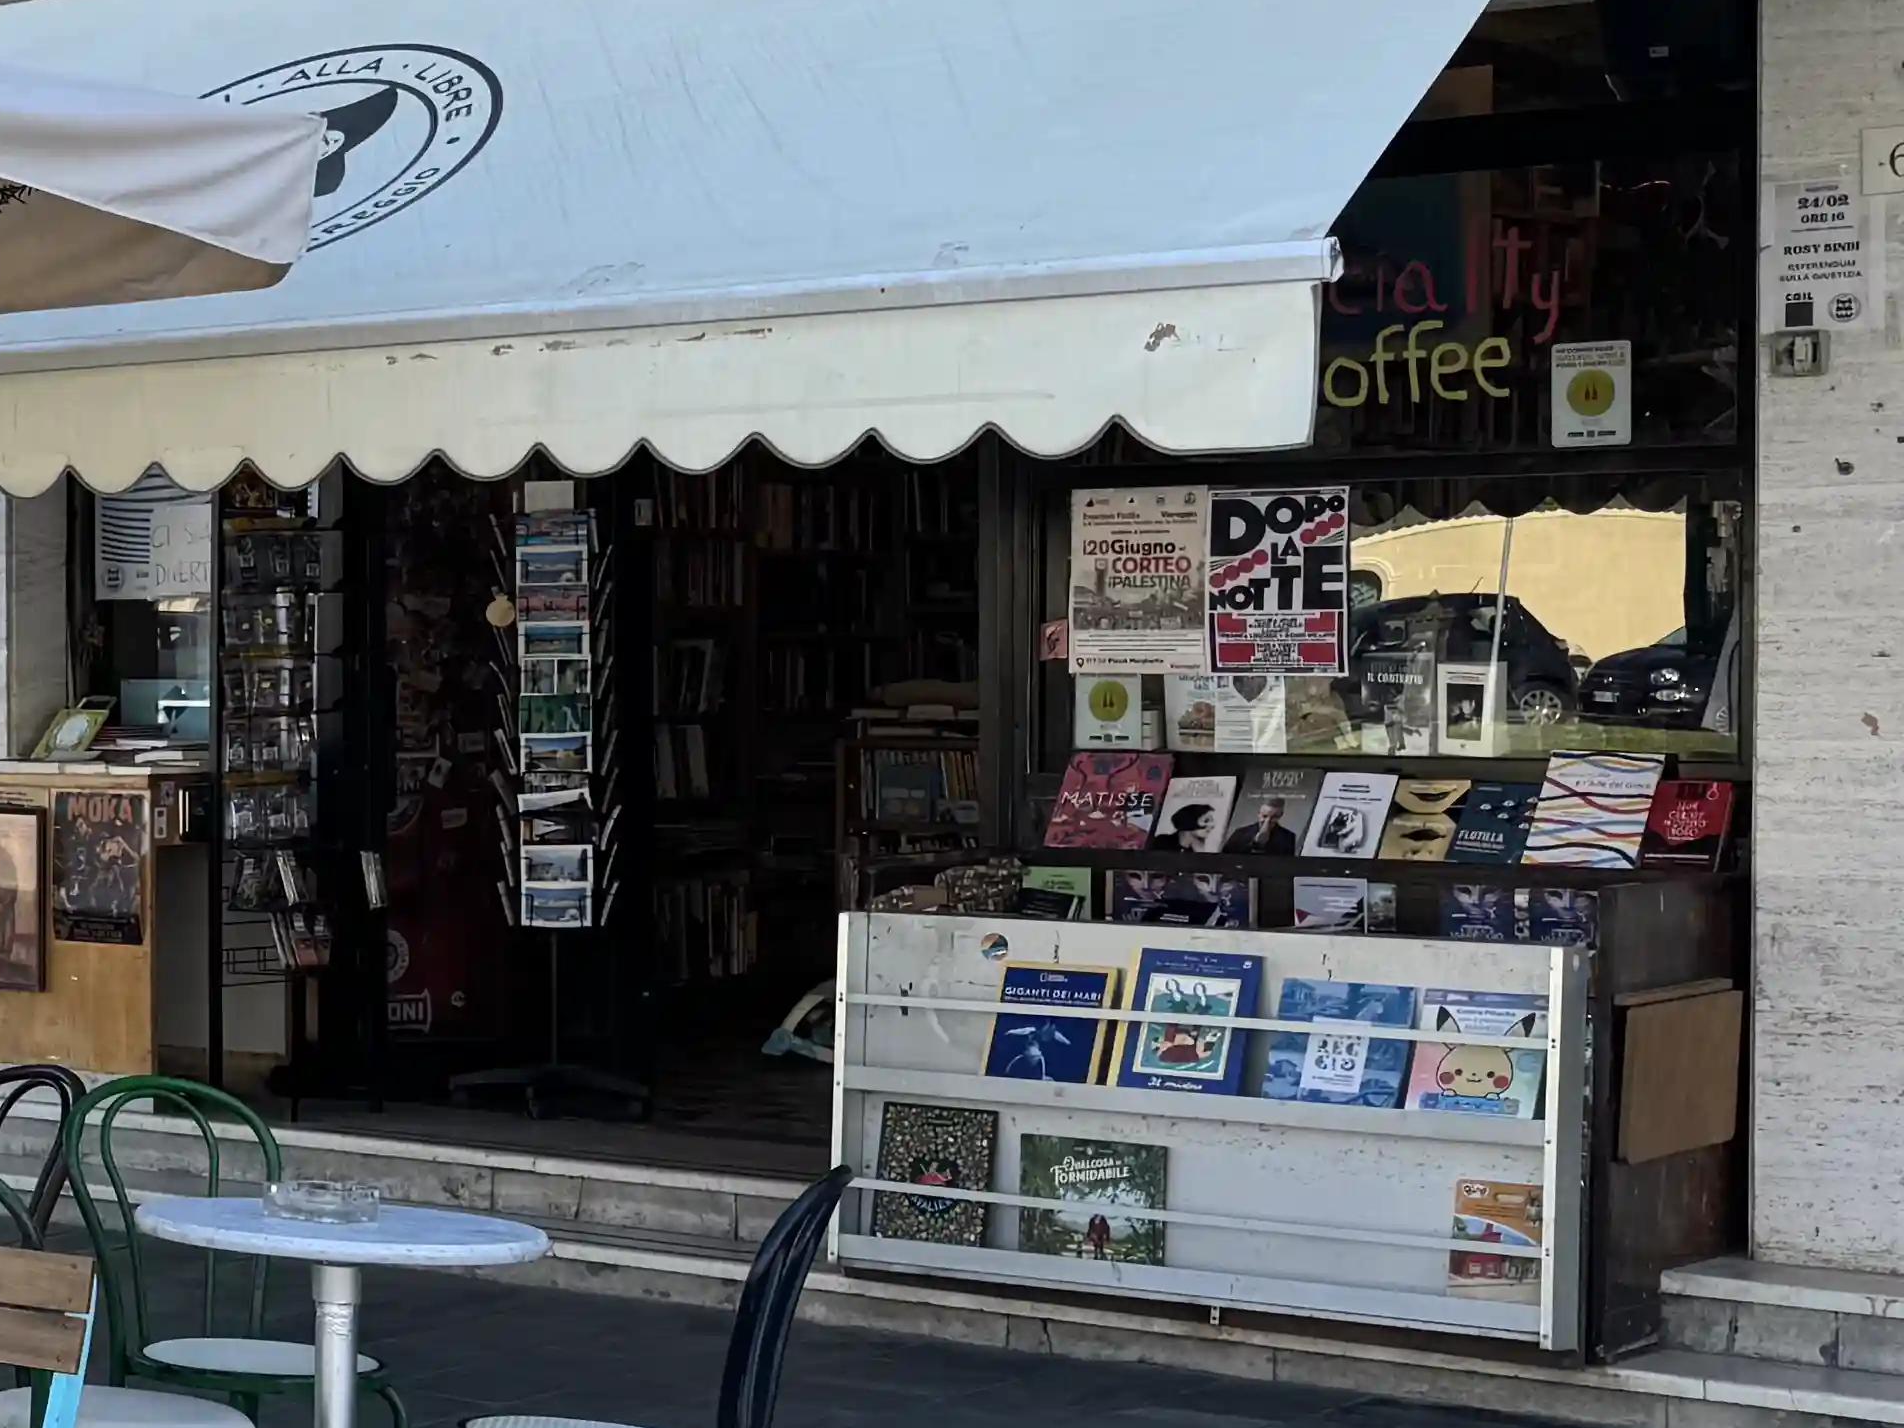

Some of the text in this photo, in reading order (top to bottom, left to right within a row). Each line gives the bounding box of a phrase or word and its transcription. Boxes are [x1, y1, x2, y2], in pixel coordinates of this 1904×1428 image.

[281, 57, 384, 86] ALLA
[414, 61, 473, 123] LIBRE
[312, 167, 441, 241] REGGIO
[1210, 495, 1346, 558] DOPO
[1110, 539, 1177, 557] Giugno
[1270, 535, 1302, 565] LA
[1111, 556, 1193, 574] CORTEO
[1209, 545, 1344, 611] NOTTE
[66, 794, 133, 823] MOKA
[1060, 791, 1155, 808] MATISSE
